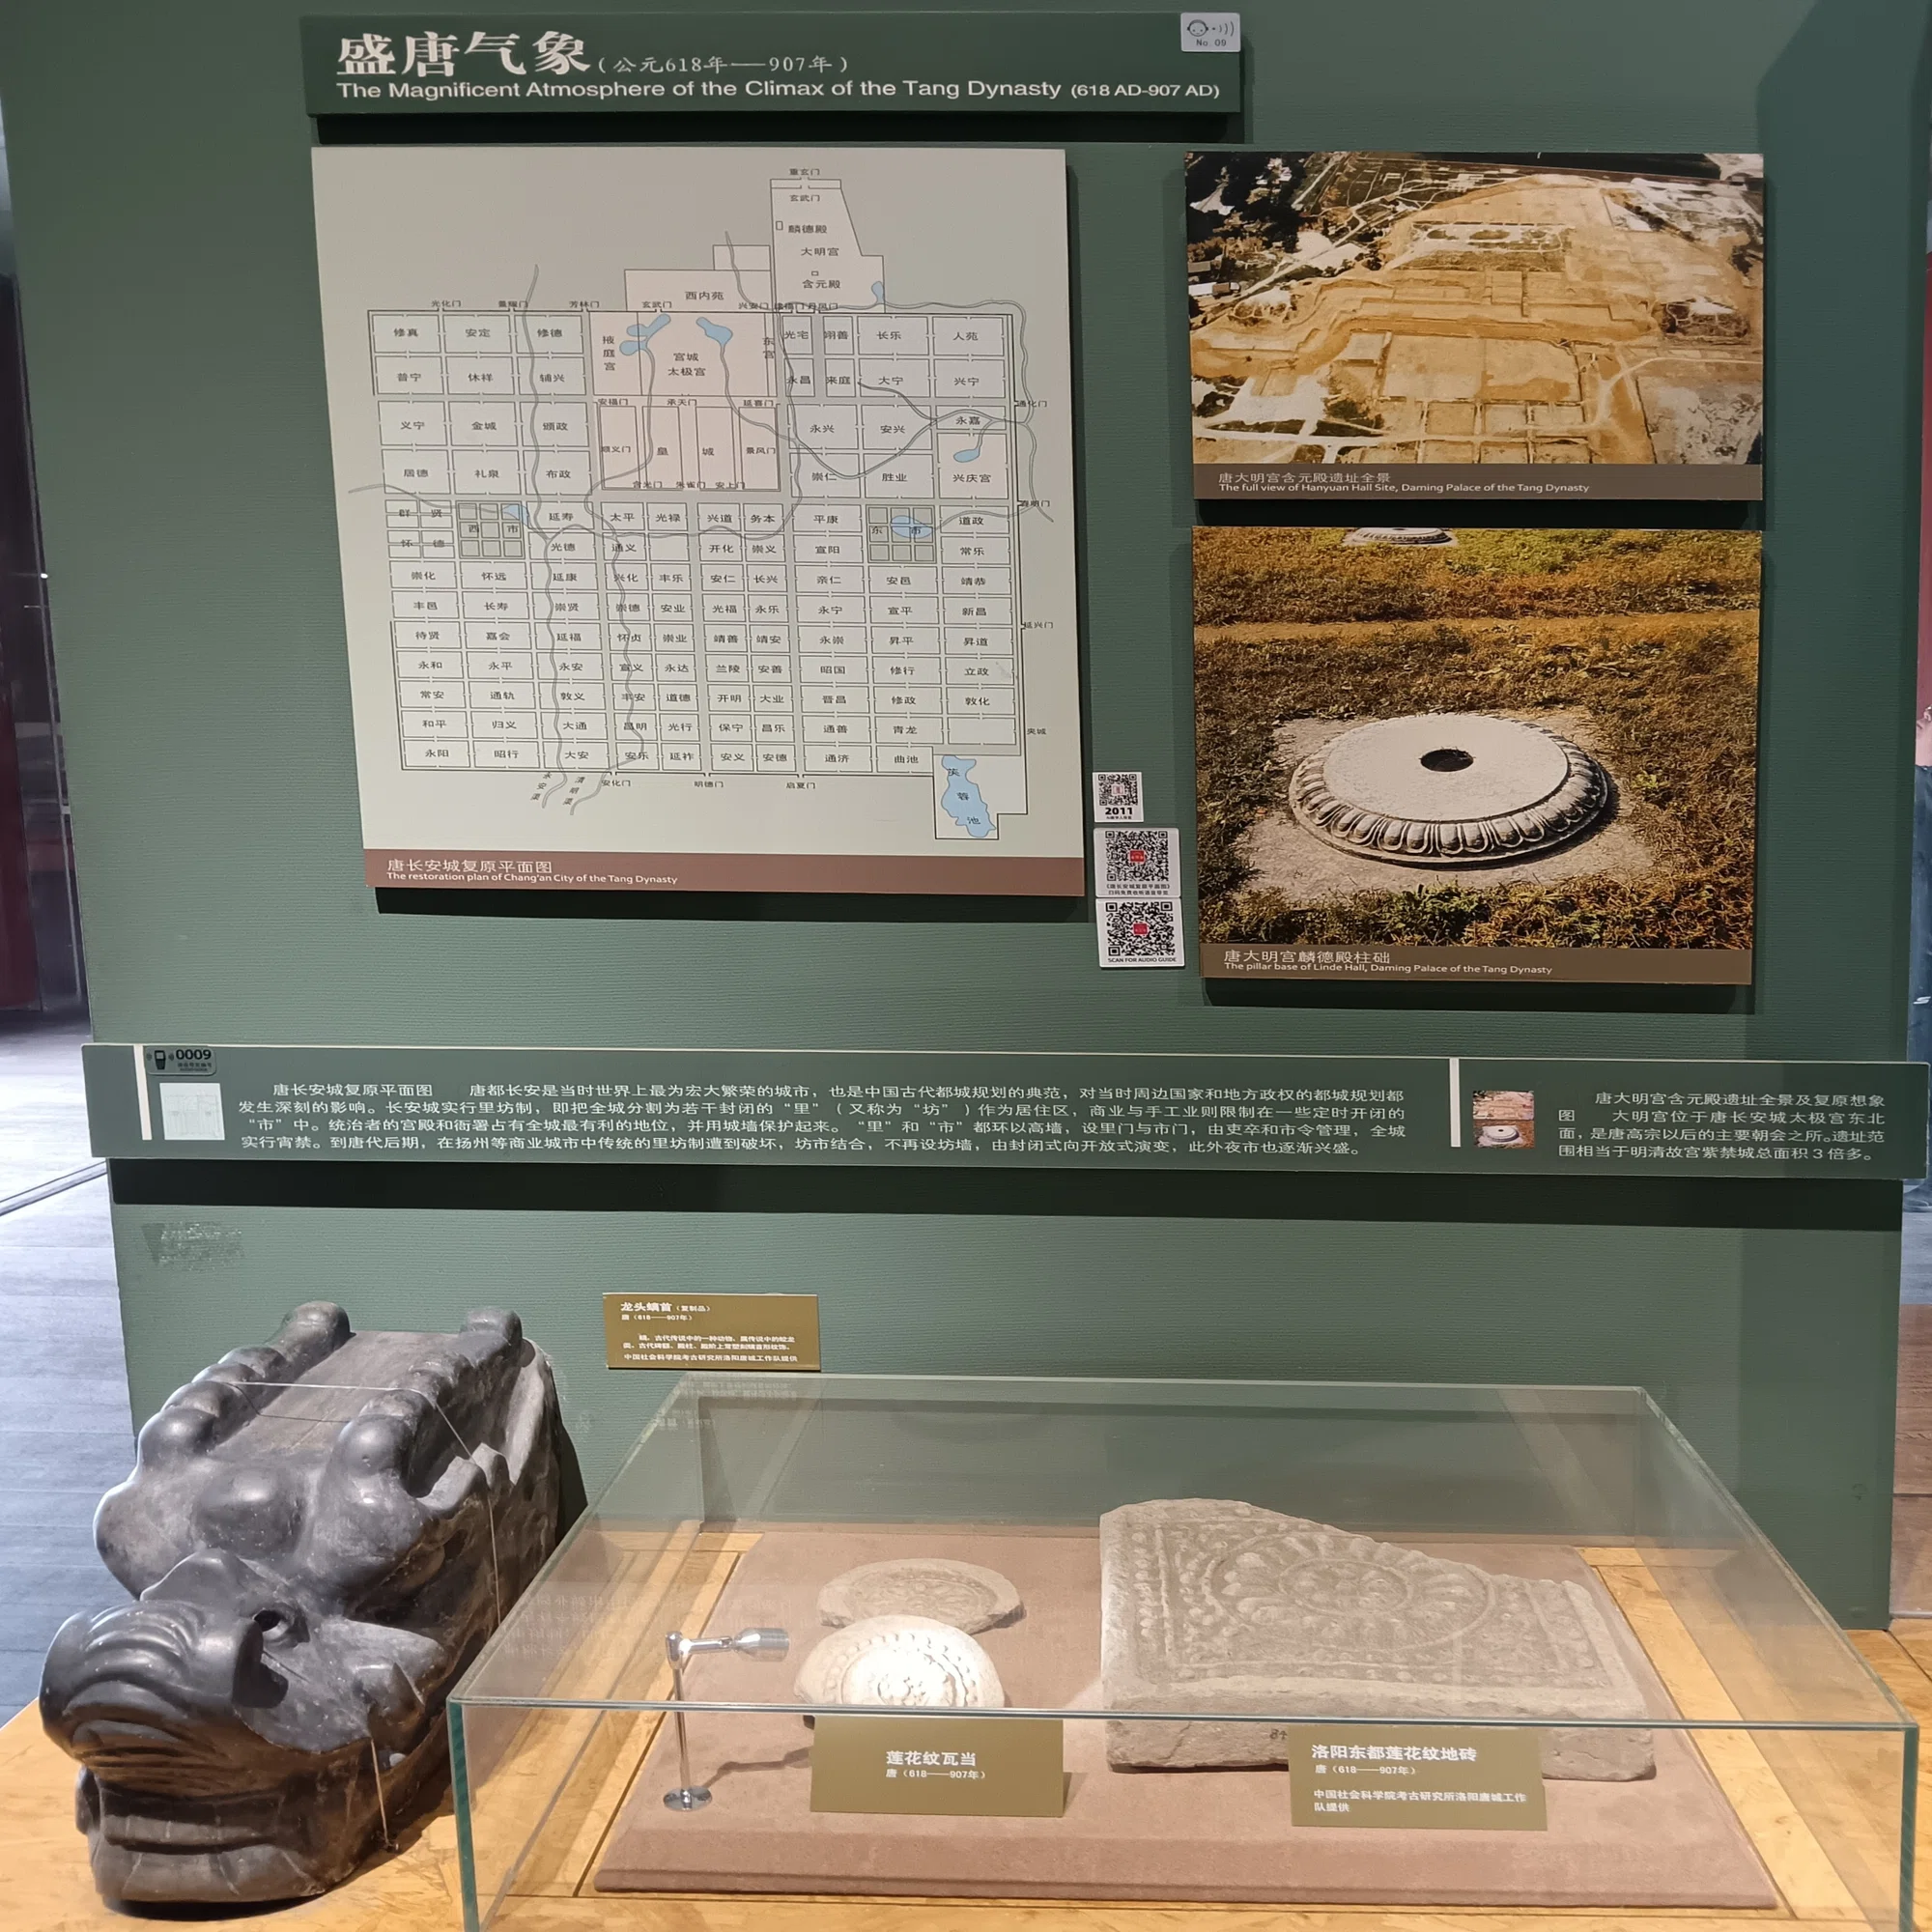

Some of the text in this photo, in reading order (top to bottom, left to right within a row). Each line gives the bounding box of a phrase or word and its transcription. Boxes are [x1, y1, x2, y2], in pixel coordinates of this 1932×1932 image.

[336, 31, 591, 77] 盛唐气象
[336, 80, 1219, 101] The Magnificent Atmosphere of the Climax of the Tang Dynasty (618 AD-907 AD)
[803, 280, 840, 289] 含元殿
[685, 292, 724, 300] 西内苑
[394, 328, 418, 337] 修真
[466, 328, 491, 337] 安定
[537, 328, 562, 337] 修德
[876, 331, 901, 340] 长乐
[673, 353, 698, 361] 宫城
[668, 367, 705, 376] 太极宫
[397, 373, 421, 382] 普宁
[956, 416, 980, 425] 永嘉
[543, 422, 568, 431] 颁政
[474, 469, 499, 478] 礼泉
[546, 470, 571, 479] 布政
[882, 473, 907, 482] 胜业
[1219, 472, 1391, 483] 唐大明宫含元殿遗址全景
[1242, 483, 1258, 492] full
[1289, 483, 1299, 492] of
[1302, 484, 1350, 494] Hanyuan
[1352, 483, 1372, 492] Hall
[1375, 483, 1399, 494] Site,
[1402, 483, 1443, 494] Daming
[1446, 483, 1481, 492] Palace
[1484, 483, 1495, 492] of
[1518, 484, 1543, 494] Tang
[1546, 484, 1590, 494] Dynasty
[656, 514, 681, 523] 光禄
[707, 514, 732, 523] 兴道
[751, 515, 775, 524] 务本
[959, 517, 984, 526] 道政
[551, 543, 576, 552] 光德
[709, 545, 734, 554] 开化
[815, 546, 839, 554] 宣阳
[482, 572, 506, 581] 怀远
[660, 574, 684, 582] 丰乐
[484, 602, 508, 611] 长寿
[962, 608, 986, 616] 新昌
[756, 636, 781, 644] 靖安
[489, 662, 513, 670] 永平
[667, 694, 691, 702] 道德
[422, 720, 446, 728] 和平
[563, 722, 587, 730] 大通
[719, 724, 743, 732] 保宁
[763, 753, 787, 762] 安德
[1105, 807, 1133, 815] 2011
[387, 859, 553, 873] 唐长安城复原平面图
[409, 872, 465, 881] restoration
[467, 873, 489, 883] plan
[491, 872, 502, 881] of
[504, 873, 552, 884] Chang'an
[554, 874, 574, 884] City
[577, 873, 587, 882] of
[609, 874, 633, 885] Tang
[636, 875, 677, 885] Dynasty
[1224, 950, 1390, 964] 唐大明宫麟德殿柱础
[1246, 962, 1271, 972] pillar
[1274, 962, 1297, 971] base
[1300, 962, 1311, 971] of
[1345, 963, 1368, 973] Hall,
[1371, 964, 1410, 974] Daming
[1414, 964, 1447, 973] Palace
[1450, 964, 1462, 973] of
[1463, 965, 1480, 974] the
[1483, 965, 1507, 976] Tang
[1510, 966, 1552, 976] Dynasty
[176, 1049, 212, 1060] 0009
[273, 1083, 433, 1097] 唐长安城复原平面图
[1595, 1092, 1886, 1107] 唐大明宫含元殿遗址全景及复原想象
[1558, 1109, 1886, 1124] 图 大明宫位于唐长安城太极宫东北
[1558, 1127, 1886, 1143] 面，是唐高宗以后的主要朝会之所。遗址范
[1314, 1789, 1526, 1803] 中国社会科学院考古研究所洛阳唐城工作
[1314, 1803, 1350, 1812] 队提供
